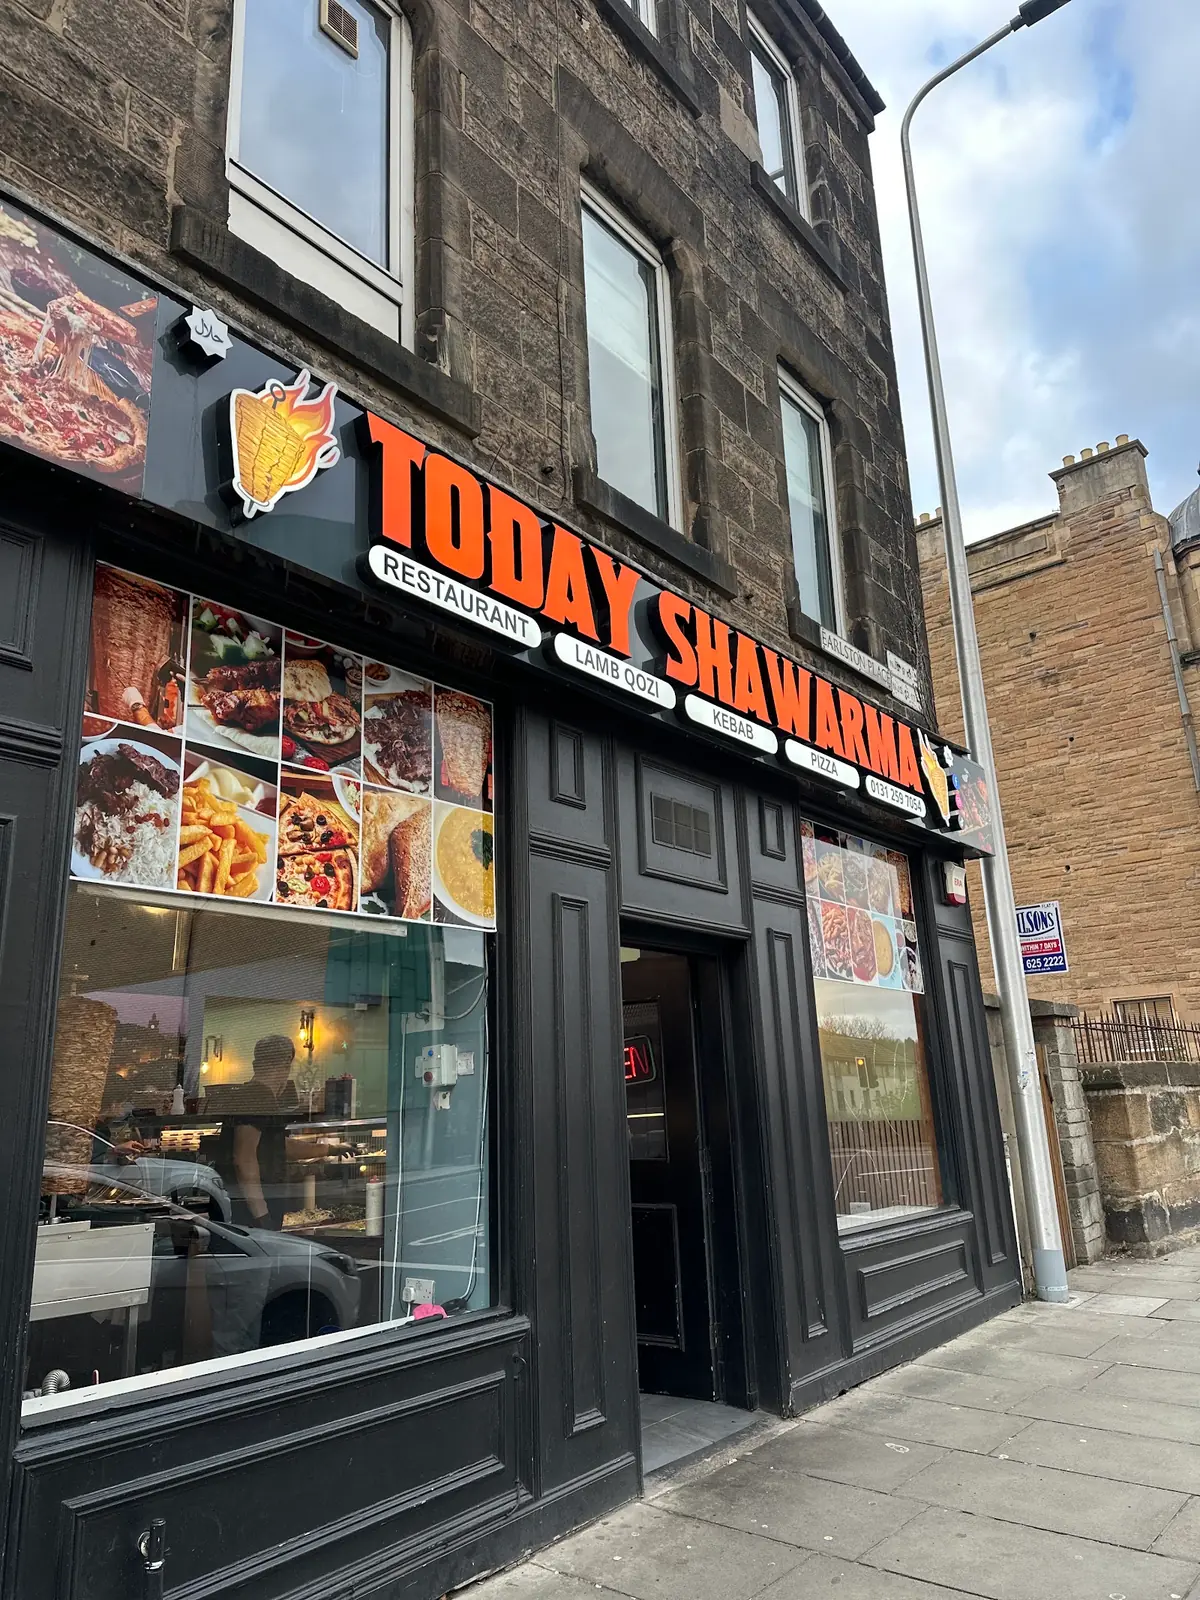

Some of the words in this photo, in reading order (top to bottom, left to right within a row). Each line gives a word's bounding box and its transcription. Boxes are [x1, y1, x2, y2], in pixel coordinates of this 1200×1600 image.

[195, 318, 224, 343] حلال
[367, 411, 642, 659] TODAY
[659, 590, 925, 793] SHAWARMA
[384, 553, 529, 638] RESTAURANT
[821, 628, 866, 669] EARLSTON
[576, 644, 620, 680] LAMB
[624, 668, 660, 698] QOZI
[712, 709, 754, 740] KEBAB
[811, 752, 839, 777] PIZZA
[870, 779, 889, 799] 0131
[890, 788, 904, 805] 259
[904, 794, 922, 812] 7054
[1016, 911, 1054, 933] ILSONS
[1026, 958, 1042, 968] 625
[1043, 956, 1064, 967] 2222
